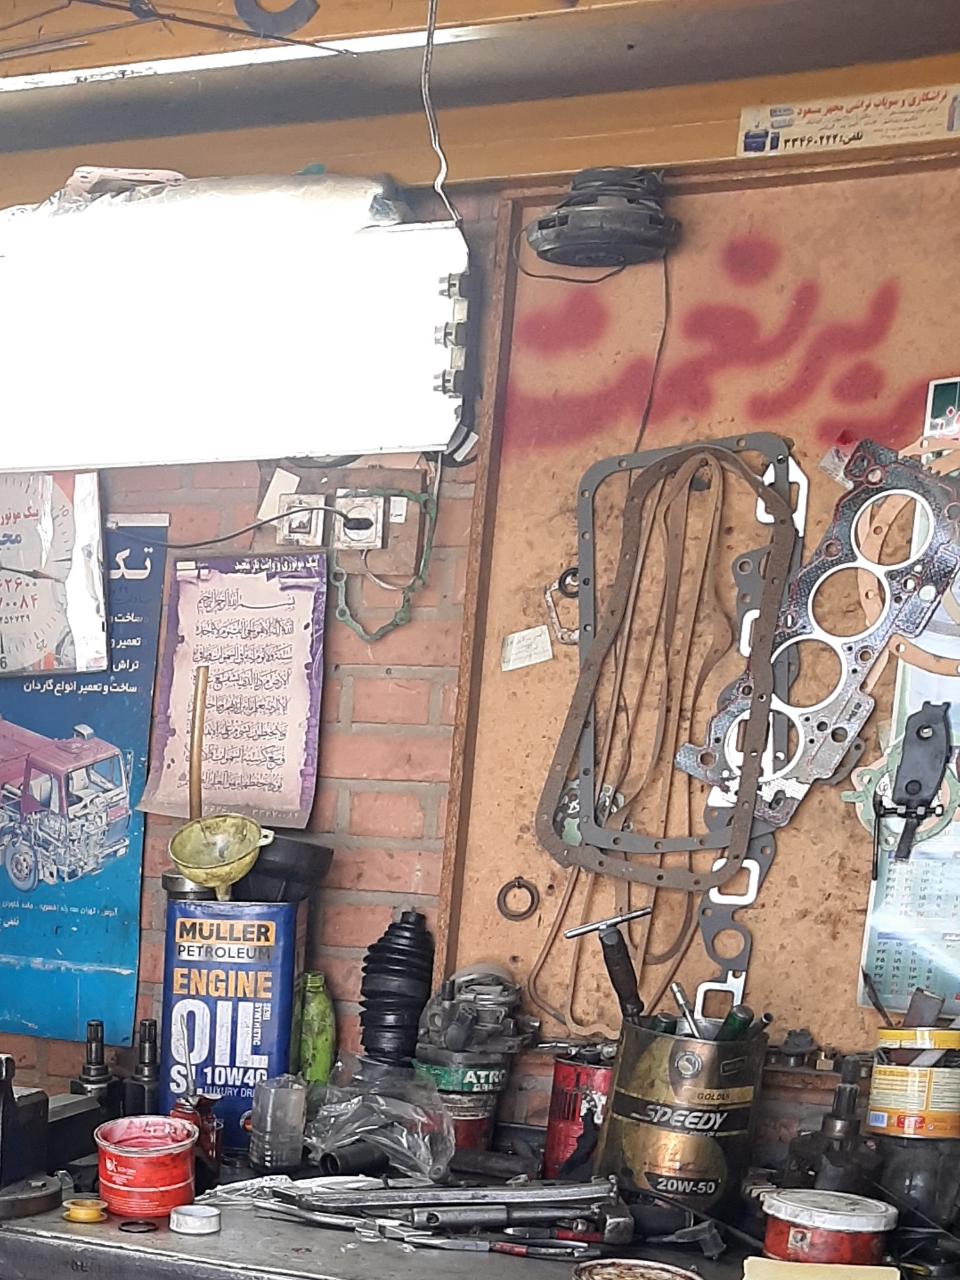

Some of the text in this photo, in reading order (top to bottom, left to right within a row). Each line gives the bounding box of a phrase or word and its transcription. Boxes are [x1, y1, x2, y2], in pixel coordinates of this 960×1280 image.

[0, 656, 7, 669] 6
[113, 659, 139, 671] تراش
[24, 680, 53, 692] گاردان
[55, 681, 76, 695] انواع
[110, 682, 137, 692] ساخت
[178, 944, 270, 960] PETROLEUM
[173, 968, 272, 998] ENGINE
[253, 1002, 263, 1046] SYNTHETIC
[170, 998, 268, 1068] OIL
[631, 1104, 728, 1130] SPEEDY
[657, 1177, 716, 1194] 20W-50
